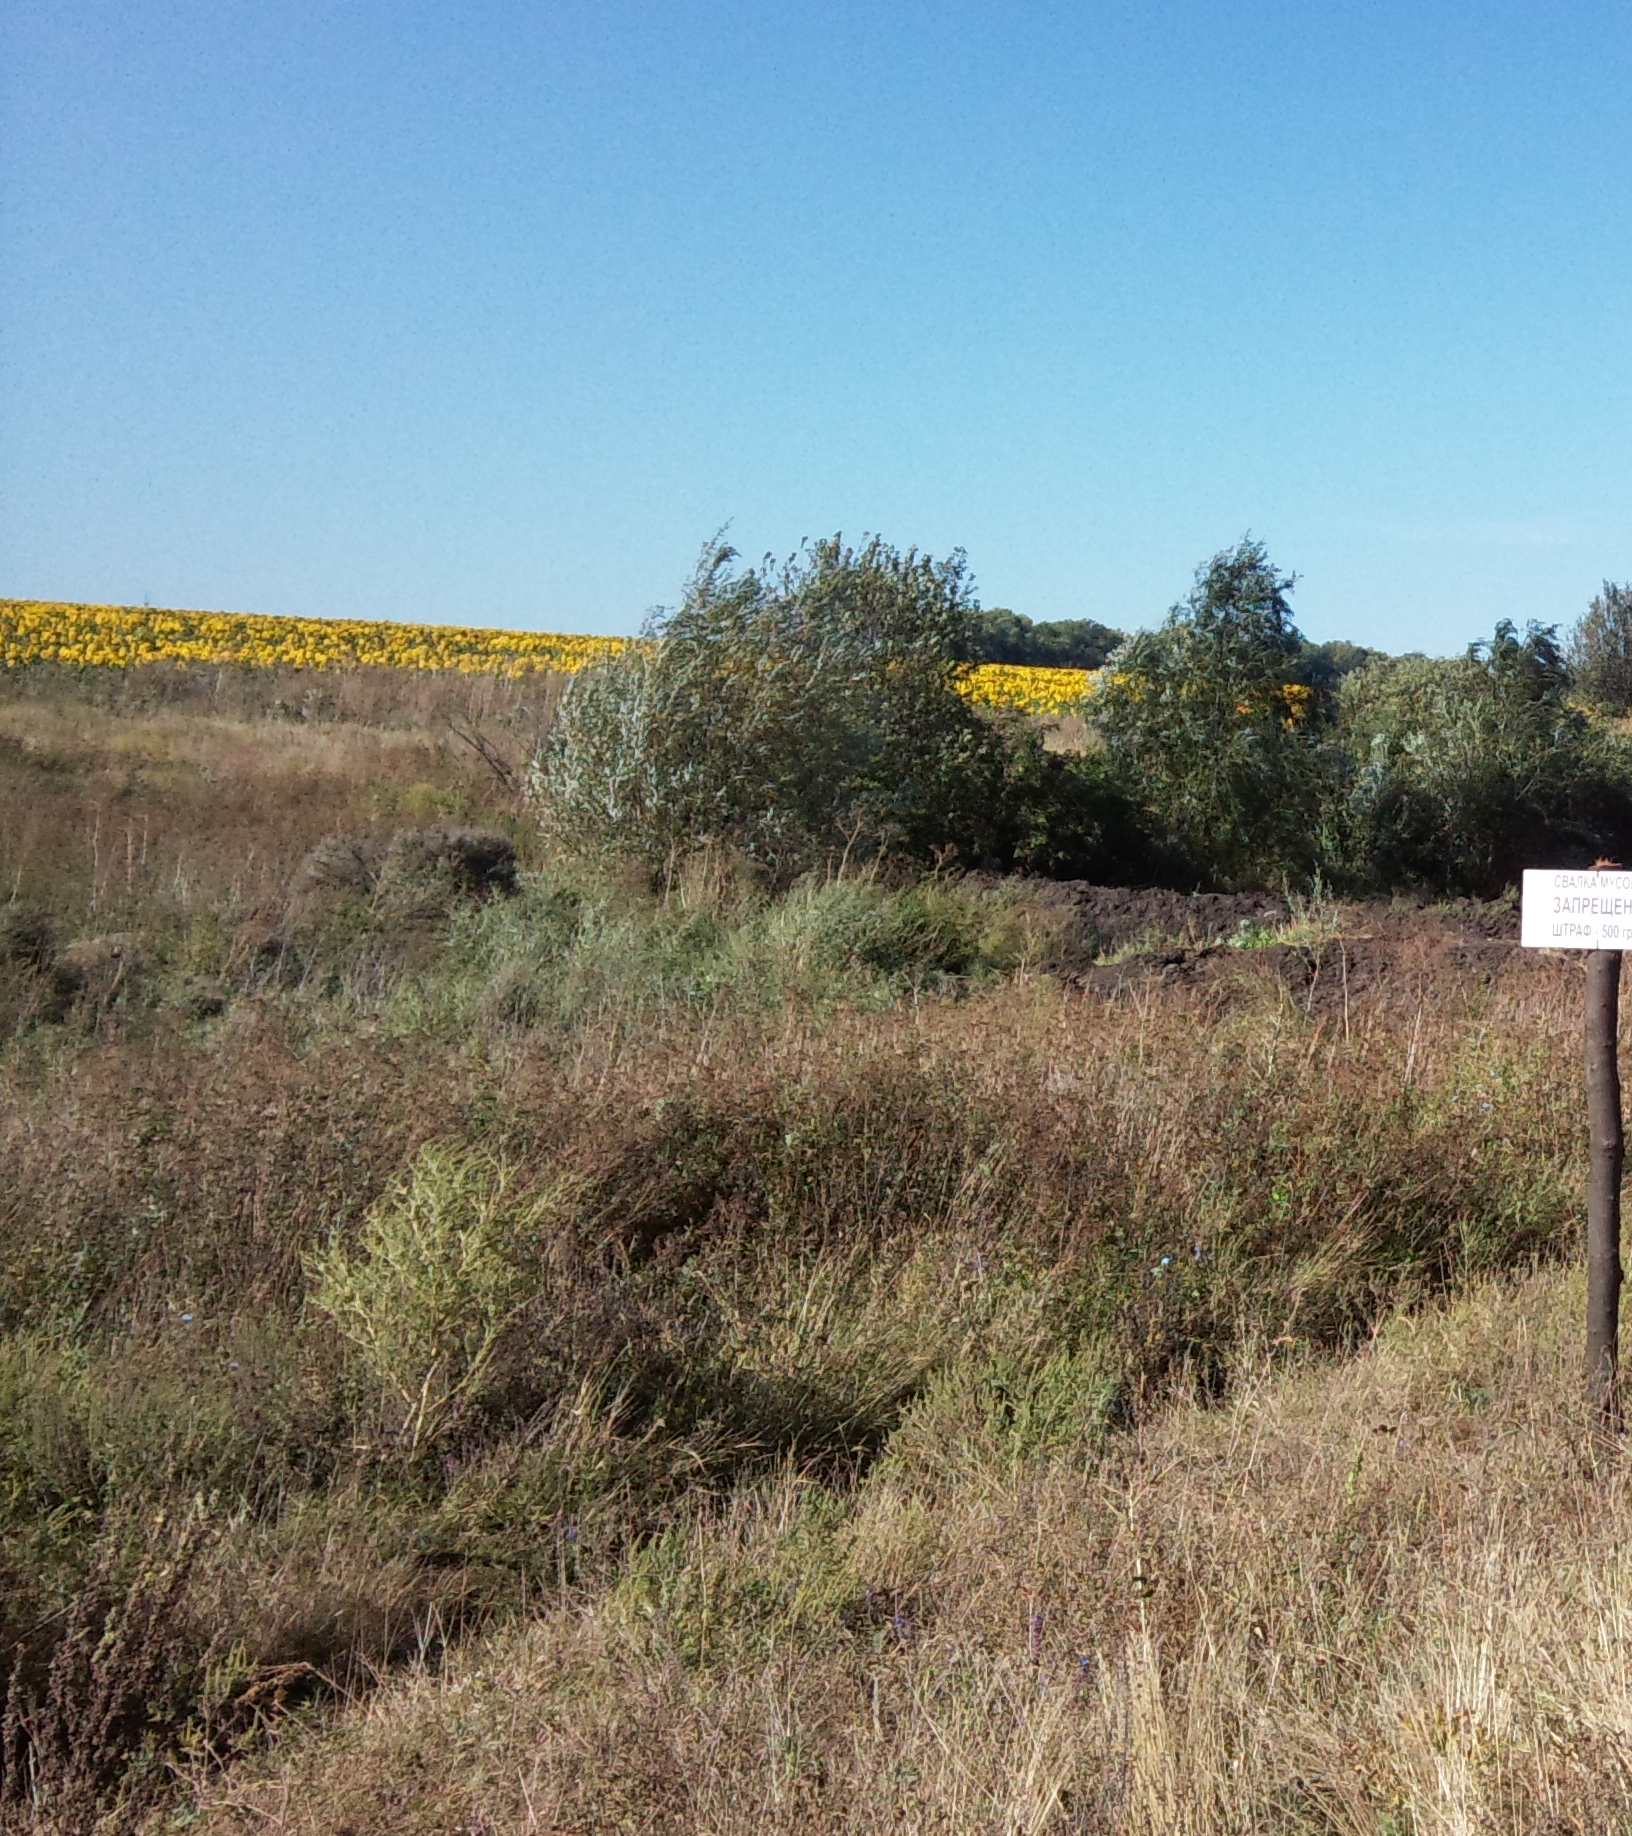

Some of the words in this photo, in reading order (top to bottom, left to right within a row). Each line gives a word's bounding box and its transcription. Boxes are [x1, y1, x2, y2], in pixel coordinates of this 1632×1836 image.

[1554, 874, 1597, 888] СВАЛКА
[1552, 923, 1592, 937] ШТРАФ
[1601, 924, 1620, 938] 500
